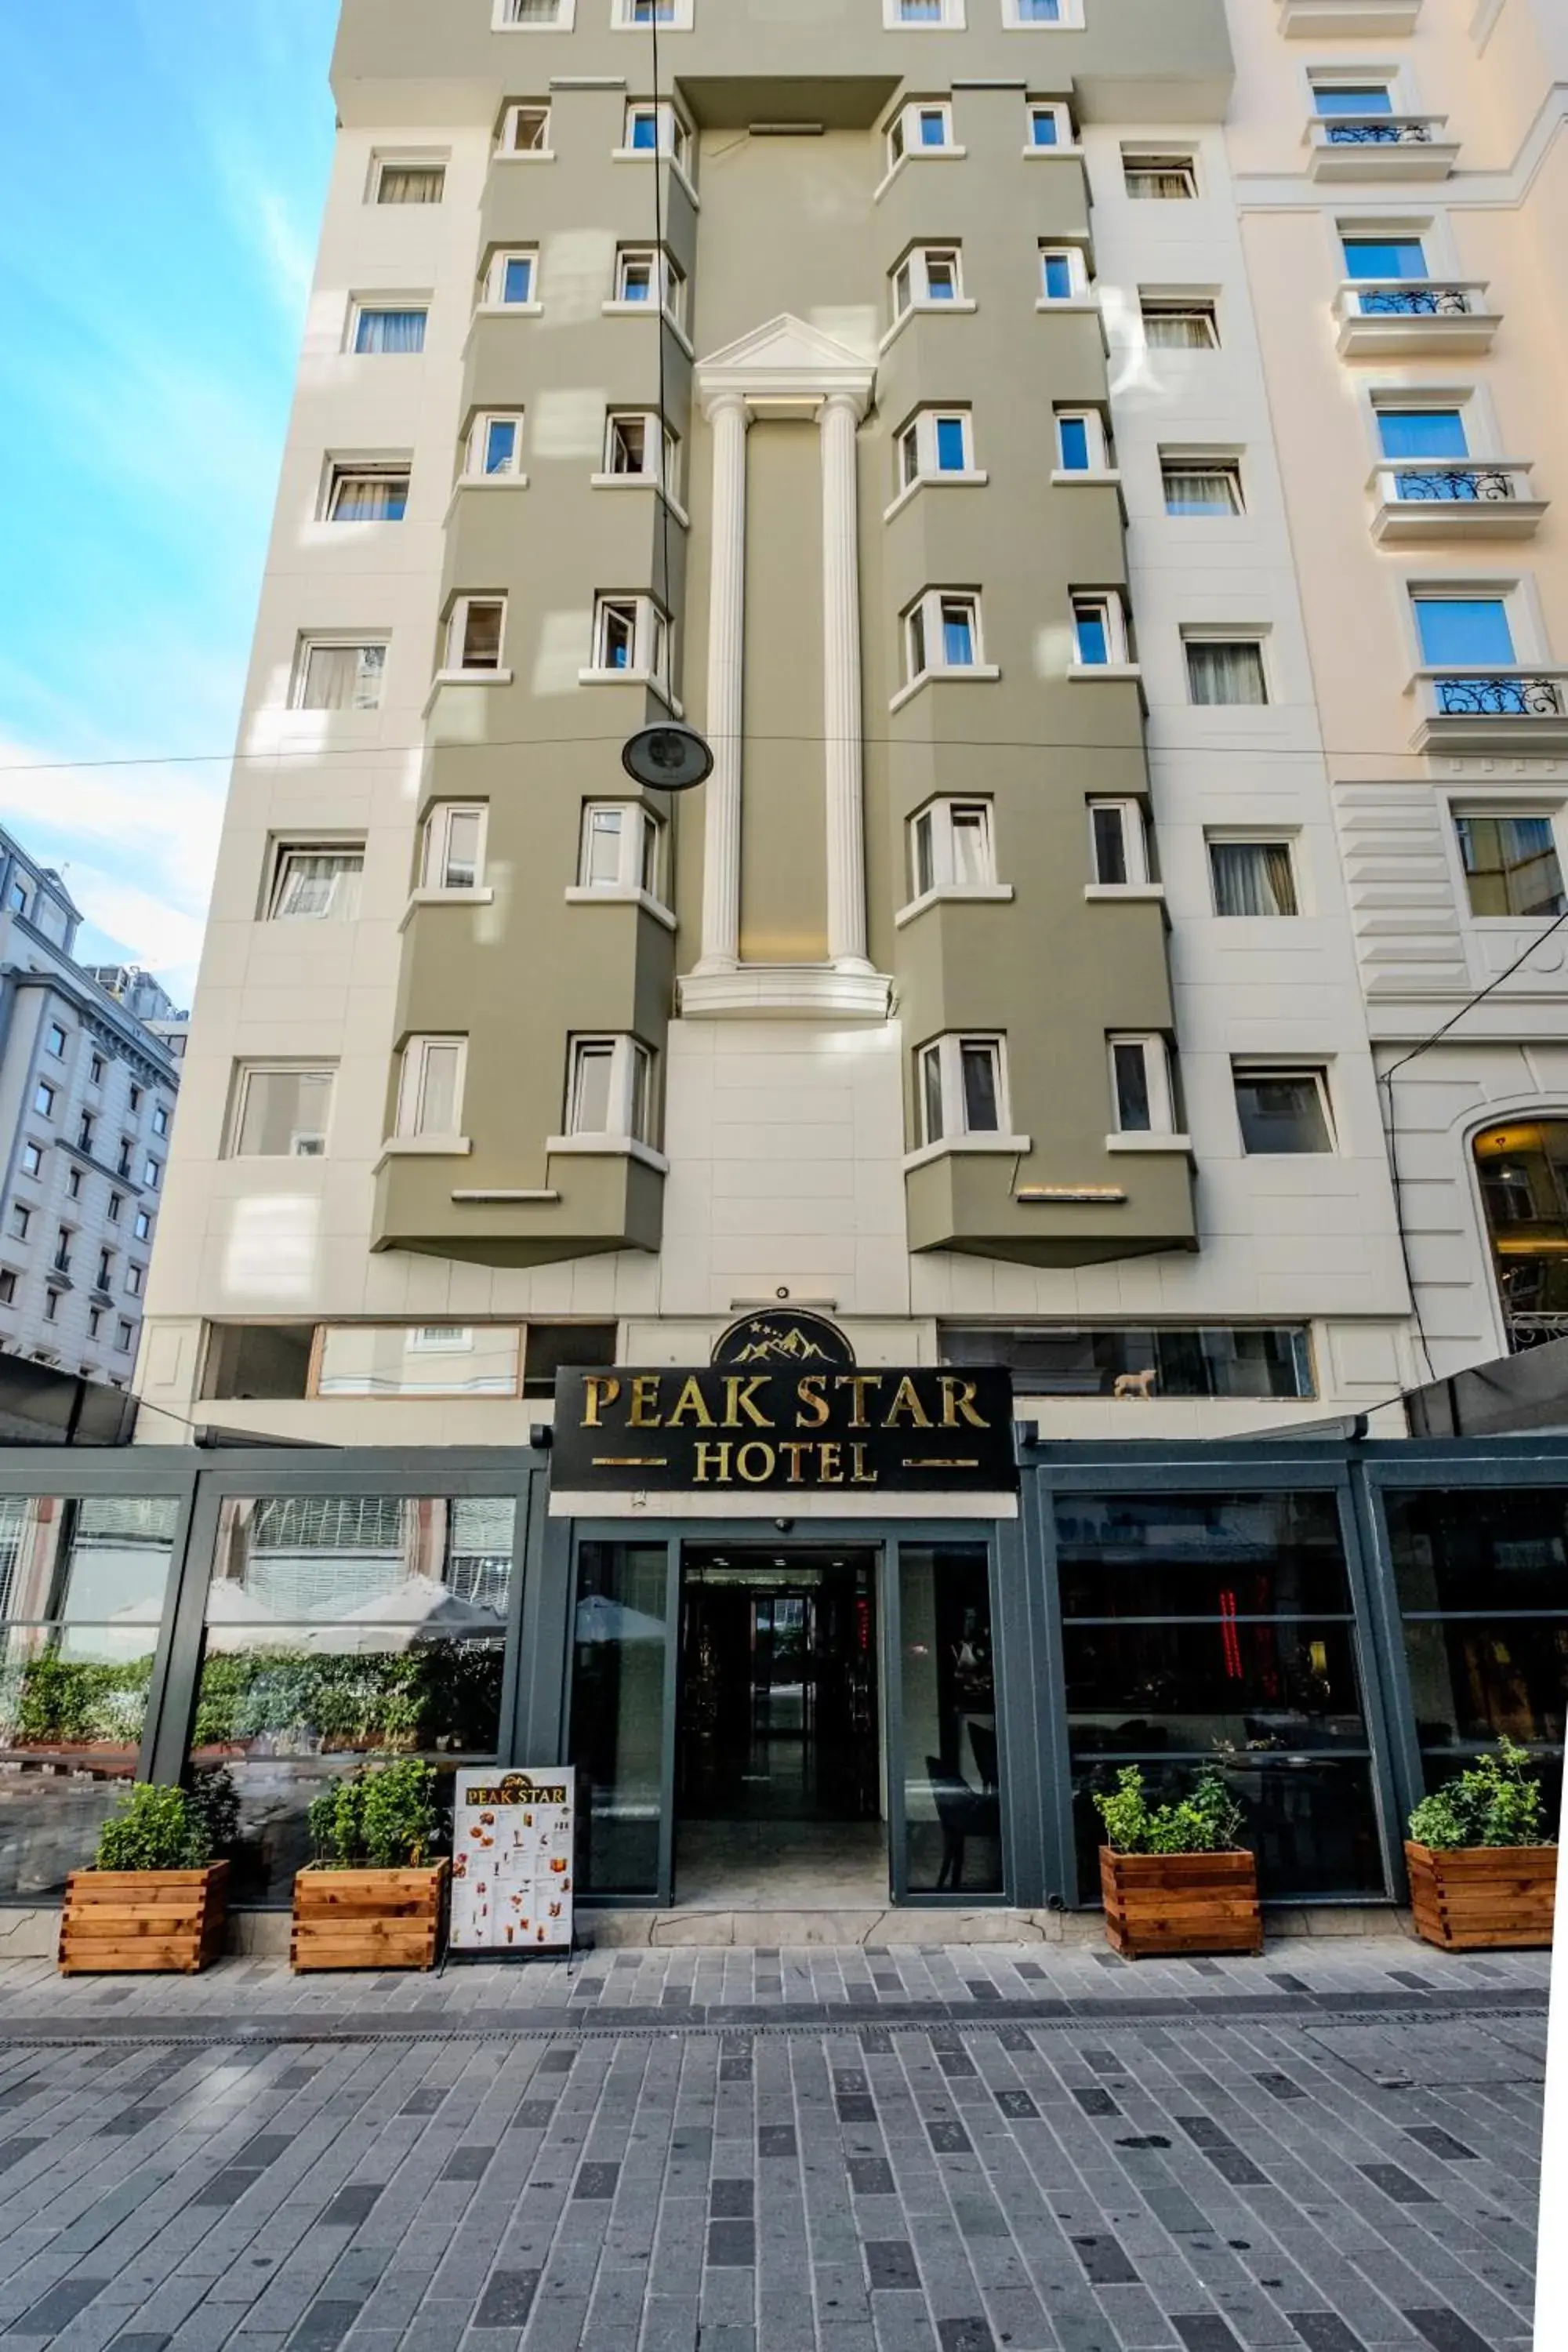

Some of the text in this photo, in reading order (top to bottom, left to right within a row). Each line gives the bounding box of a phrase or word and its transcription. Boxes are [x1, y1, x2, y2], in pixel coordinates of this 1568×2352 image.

[579, 1374, 992, 1428] PEAK STAR
[692, 1441, 877, 1483] HOTEL
[467, 1788, 564, 1804] PEAK STAR
